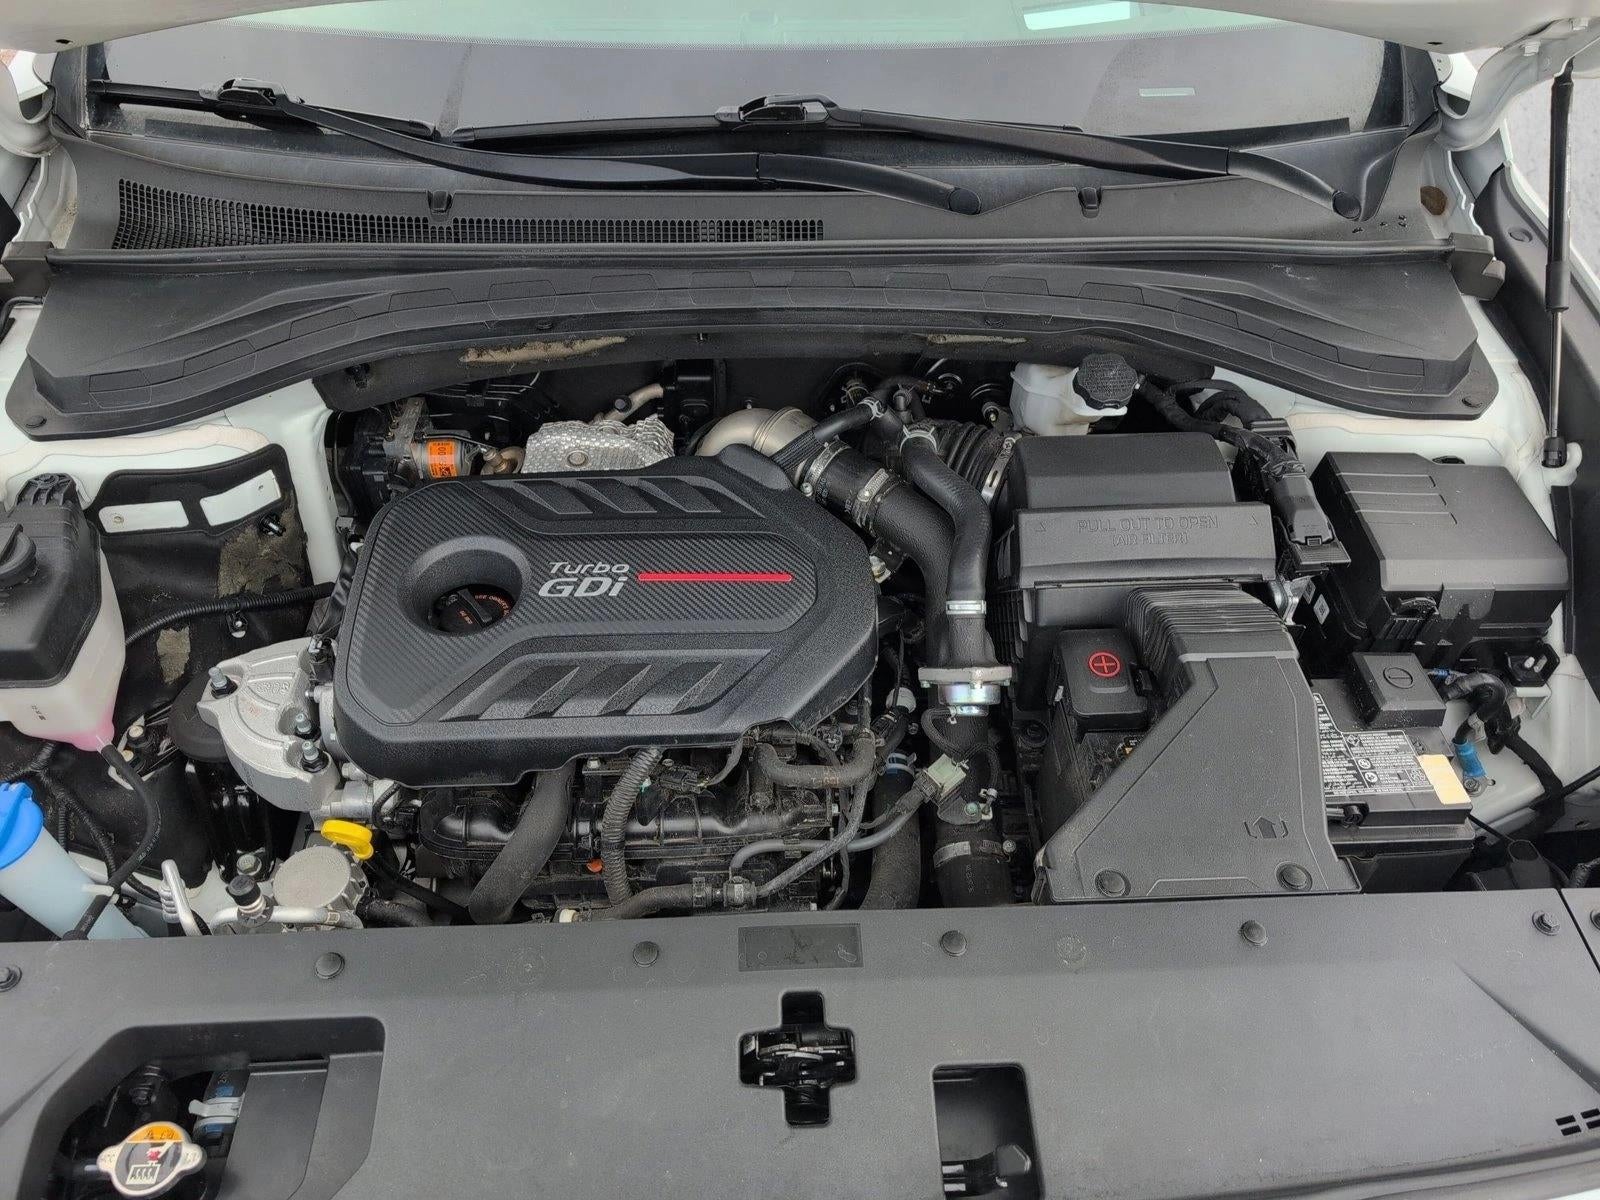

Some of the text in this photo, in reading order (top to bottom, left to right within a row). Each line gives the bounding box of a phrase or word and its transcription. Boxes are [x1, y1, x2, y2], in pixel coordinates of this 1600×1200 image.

[1077, 515, 1219, 533] PULL OUT TO OPEN
[549, 561, 630, 574] Turbo
[538, 576, 629, 597] GDi
